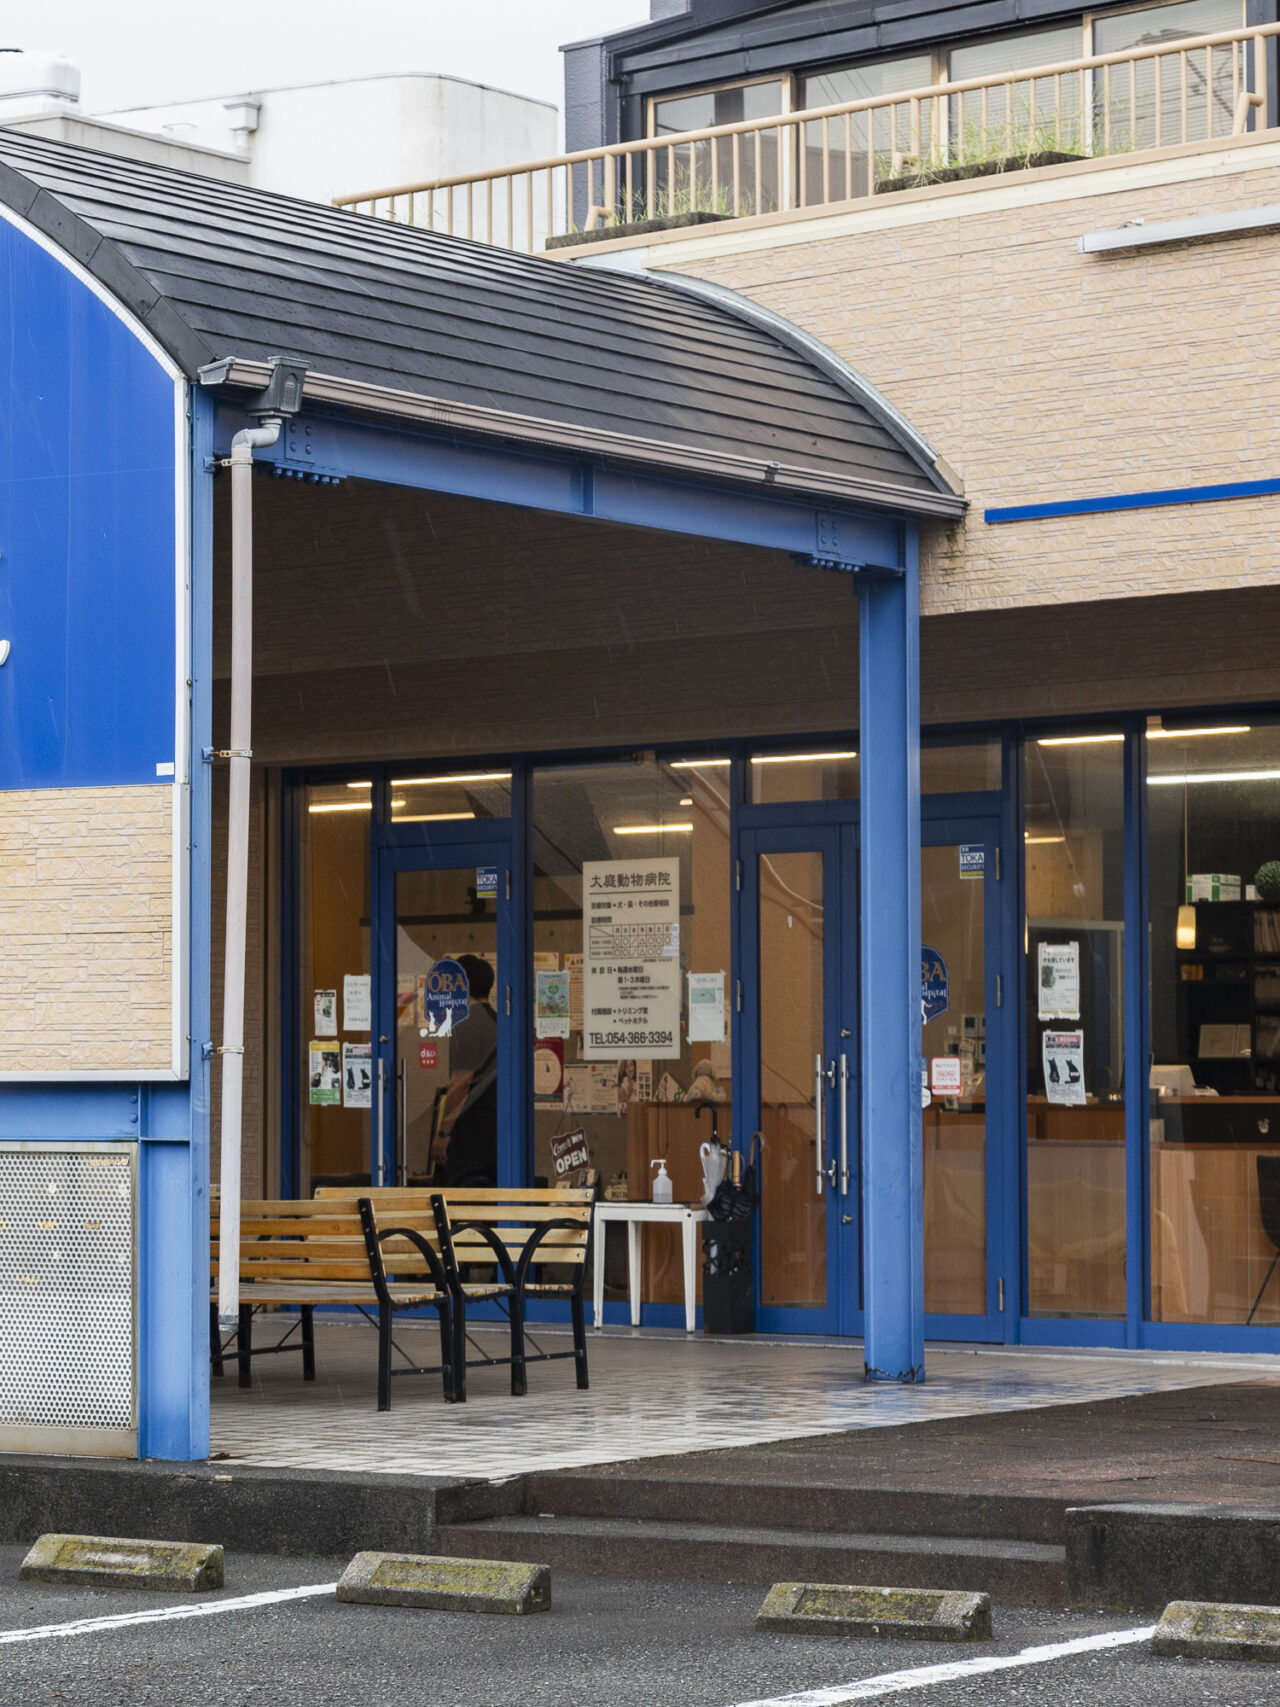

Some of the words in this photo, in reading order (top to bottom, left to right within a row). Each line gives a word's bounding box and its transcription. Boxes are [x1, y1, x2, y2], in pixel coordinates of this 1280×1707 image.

[590, 872, 671, 888] 大庭動物病院
[921, 961, 946, 982] BA
[428, 992, 452, 1001] Animal
[439, 998, 467, 1009] Hospital
[556, 1146, 588, 1174] OPEN
